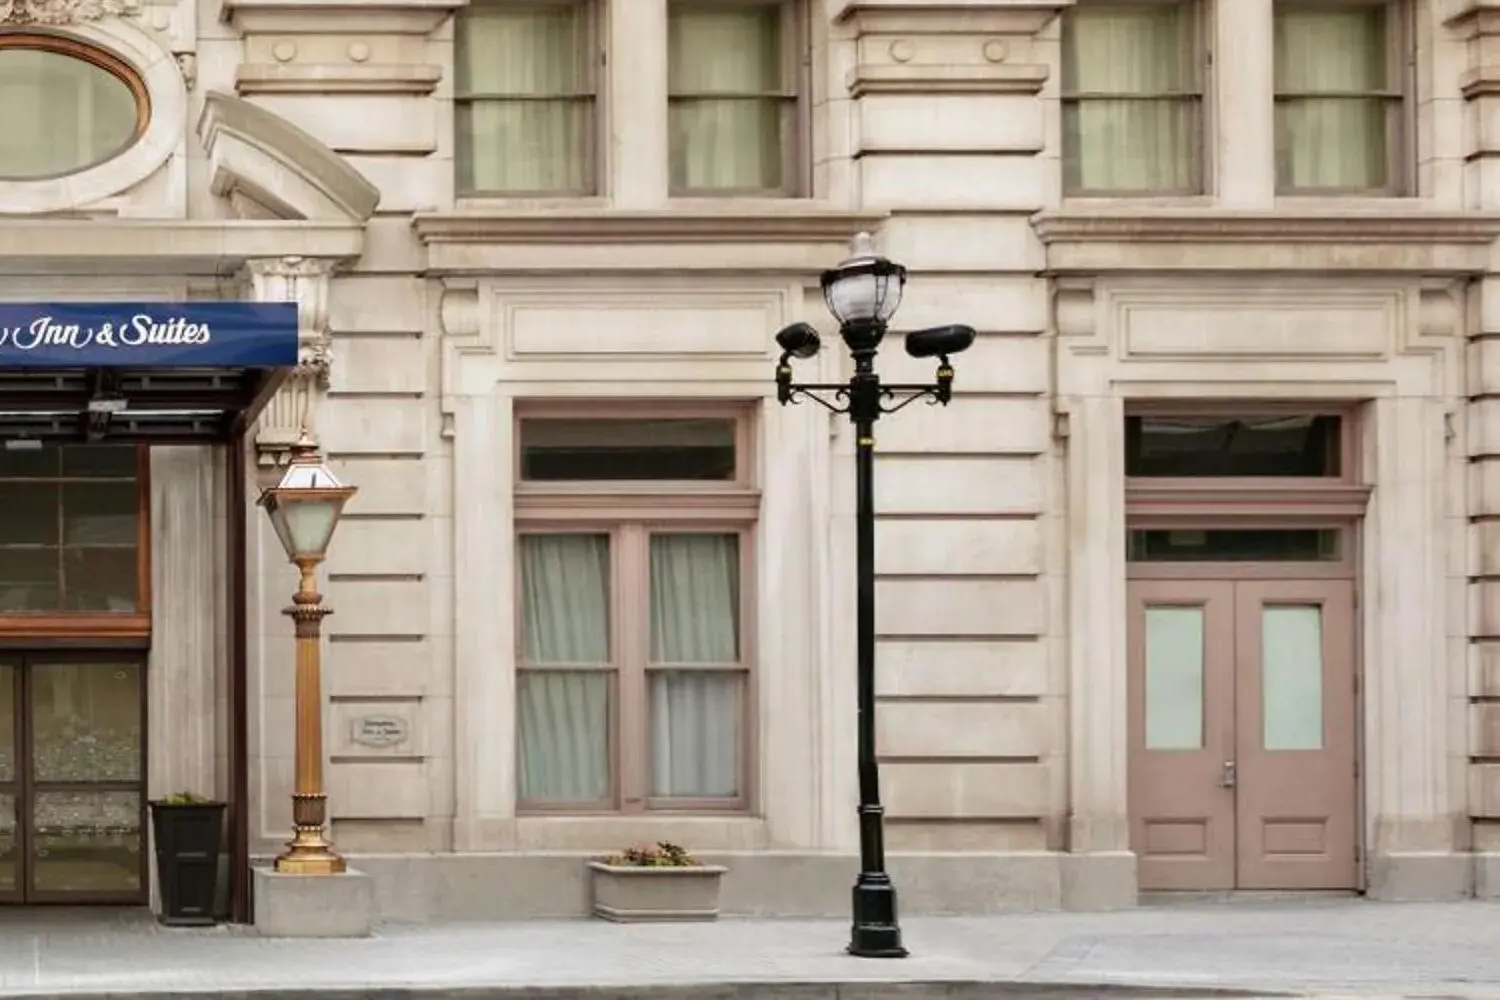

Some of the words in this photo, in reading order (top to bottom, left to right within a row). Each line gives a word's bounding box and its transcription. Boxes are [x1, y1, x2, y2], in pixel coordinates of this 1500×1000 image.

[11, 316, 93, 349] Inn
[95, 322, 117, 348] &
[119, 314, 211, 345] Suites
